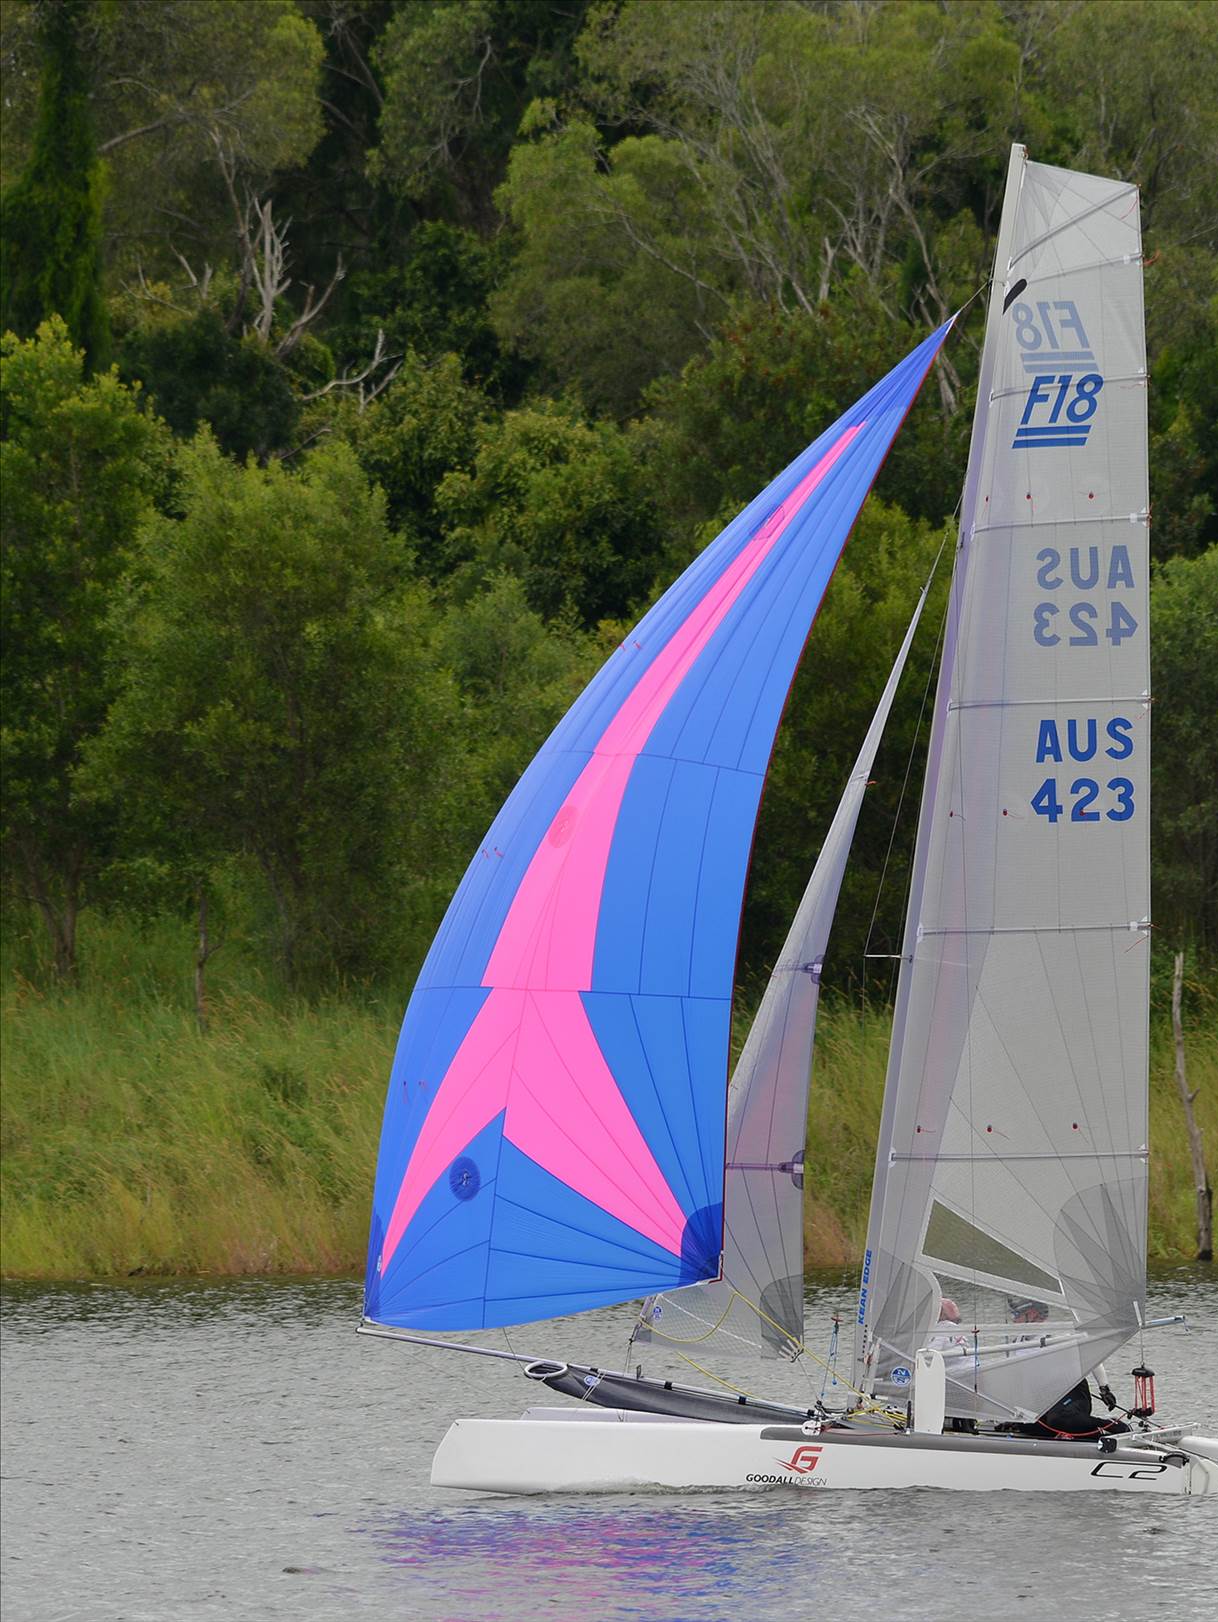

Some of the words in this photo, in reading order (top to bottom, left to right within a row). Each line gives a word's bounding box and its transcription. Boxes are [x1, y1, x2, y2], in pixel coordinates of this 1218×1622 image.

[1020, 373, 1104, 425] F18
[1035, 717, 1134, 763] AUS
[1030, 777, 1135, 823] 423
[863, 1249, 872, 1284] EDGE
